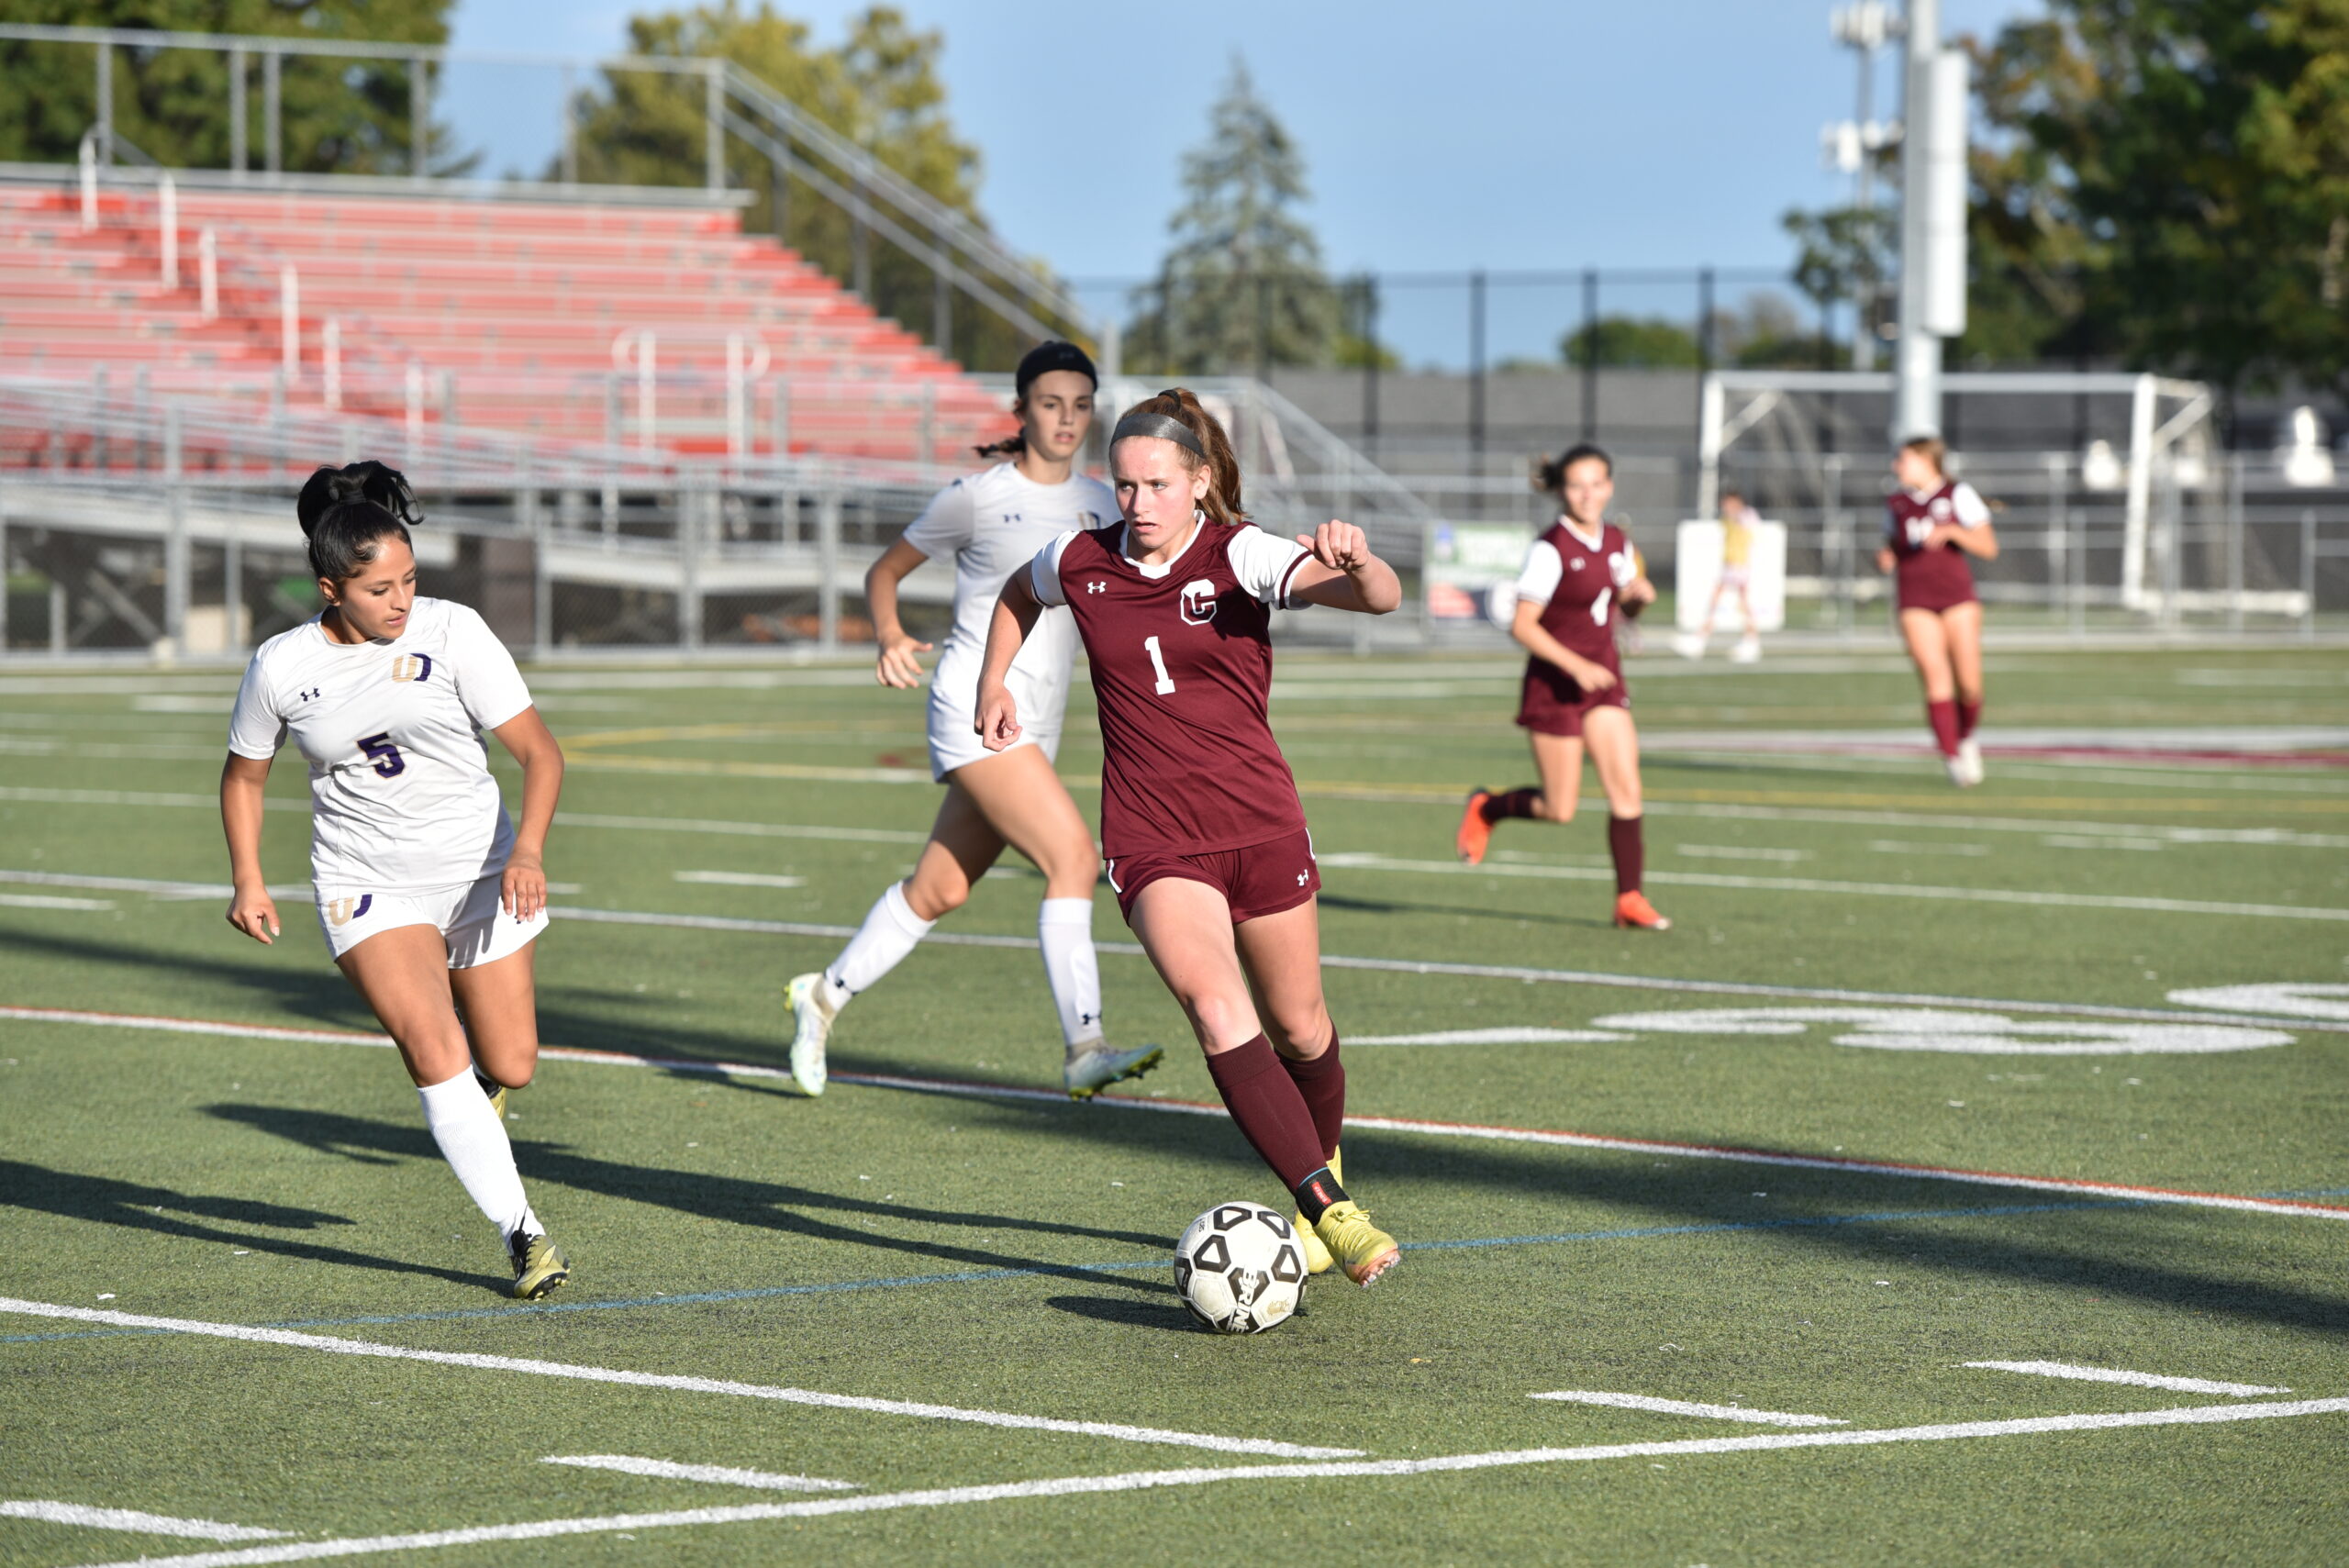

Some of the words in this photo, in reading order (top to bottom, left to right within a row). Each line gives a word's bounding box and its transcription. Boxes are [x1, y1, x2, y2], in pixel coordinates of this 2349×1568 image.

[1181, 579, 1217, 626] C
[1144, 636, 1175, 695] 1
[356, 732, 407, 779] 5
[1230, 1266, 1259, 1333] BRINE
